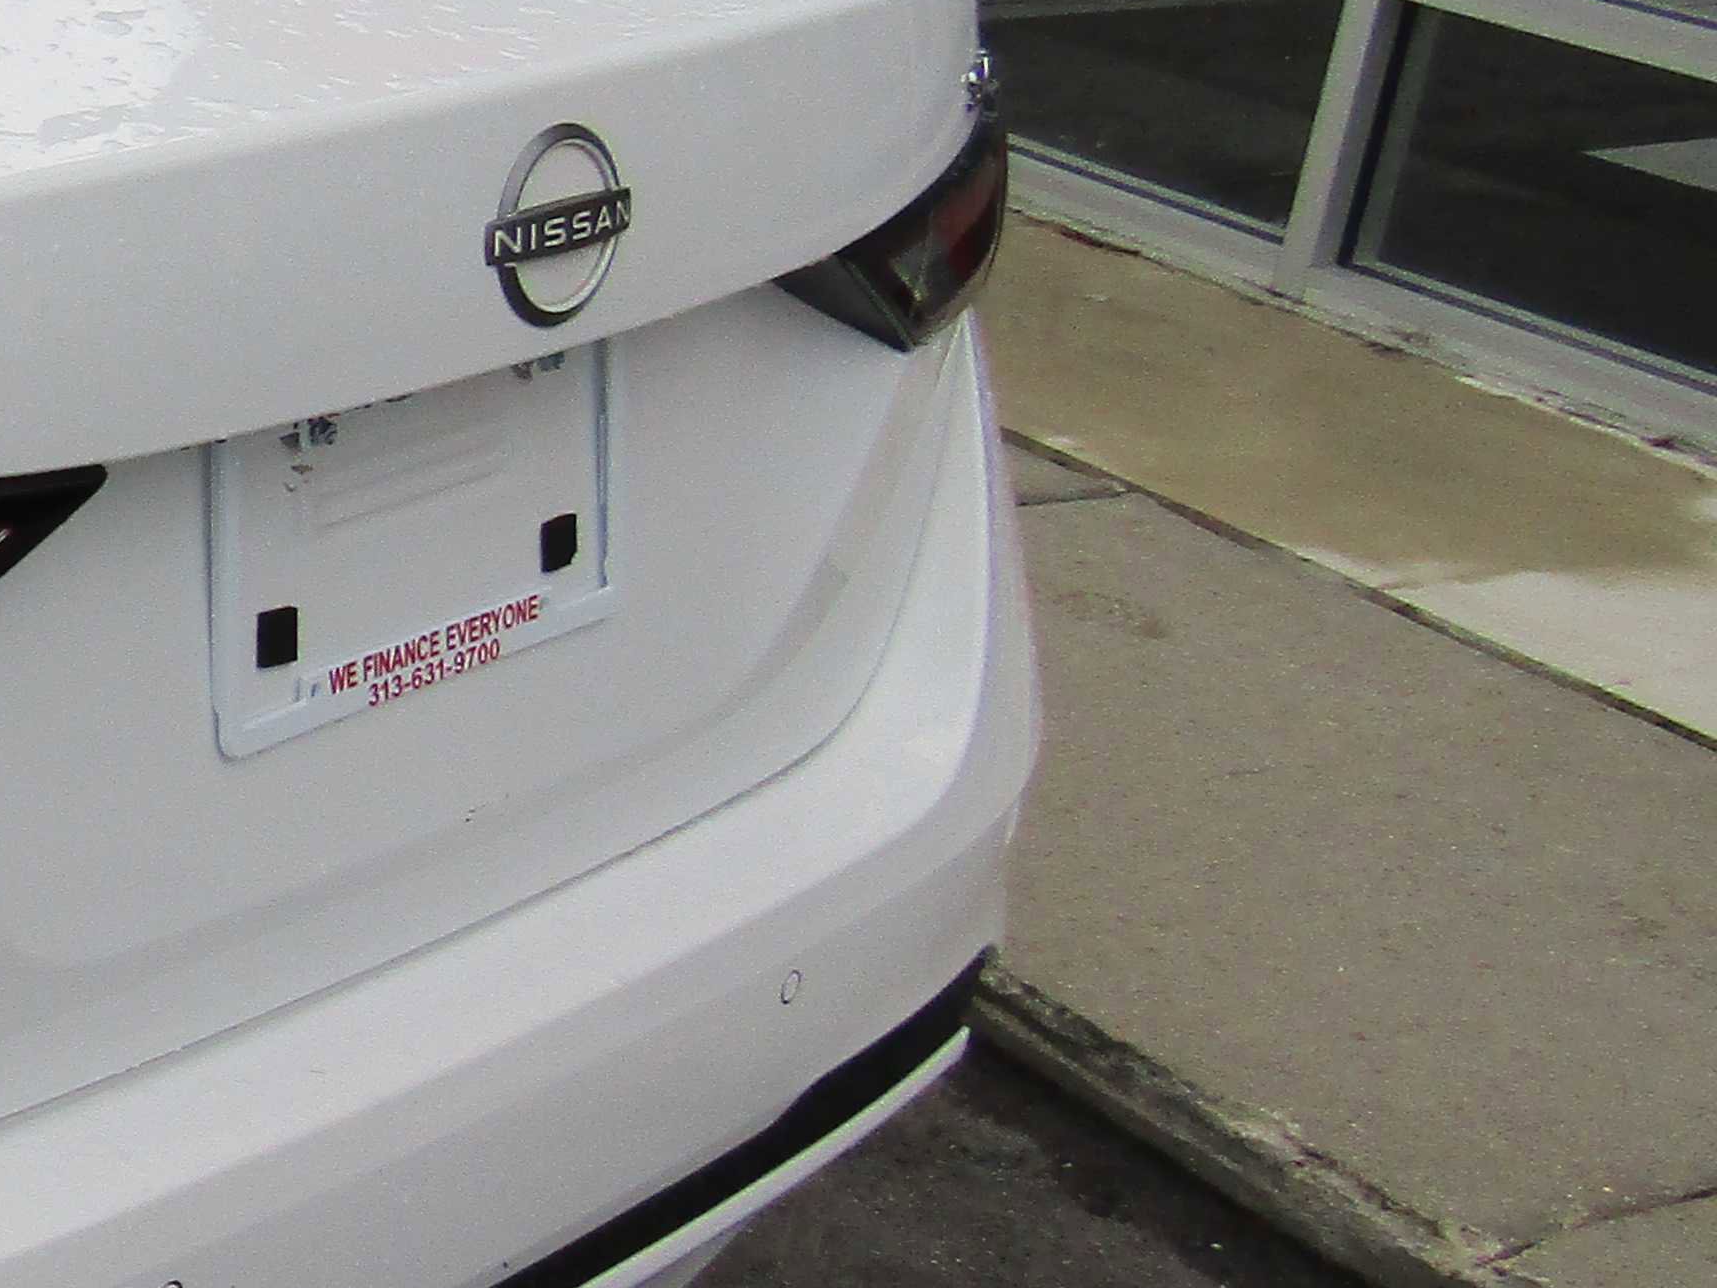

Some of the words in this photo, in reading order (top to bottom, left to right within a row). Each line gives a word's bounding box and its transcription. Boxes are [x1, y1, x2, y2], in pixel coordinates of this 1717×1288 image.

[493, 199, 630, 258] NISSAN
[329, 662, 358, 694] WE
[363, 630, 440, 682] FINANCE
[446, 594, 541, 651] EVERYONE
[368, 638, 501, 707] 313-631-9700
